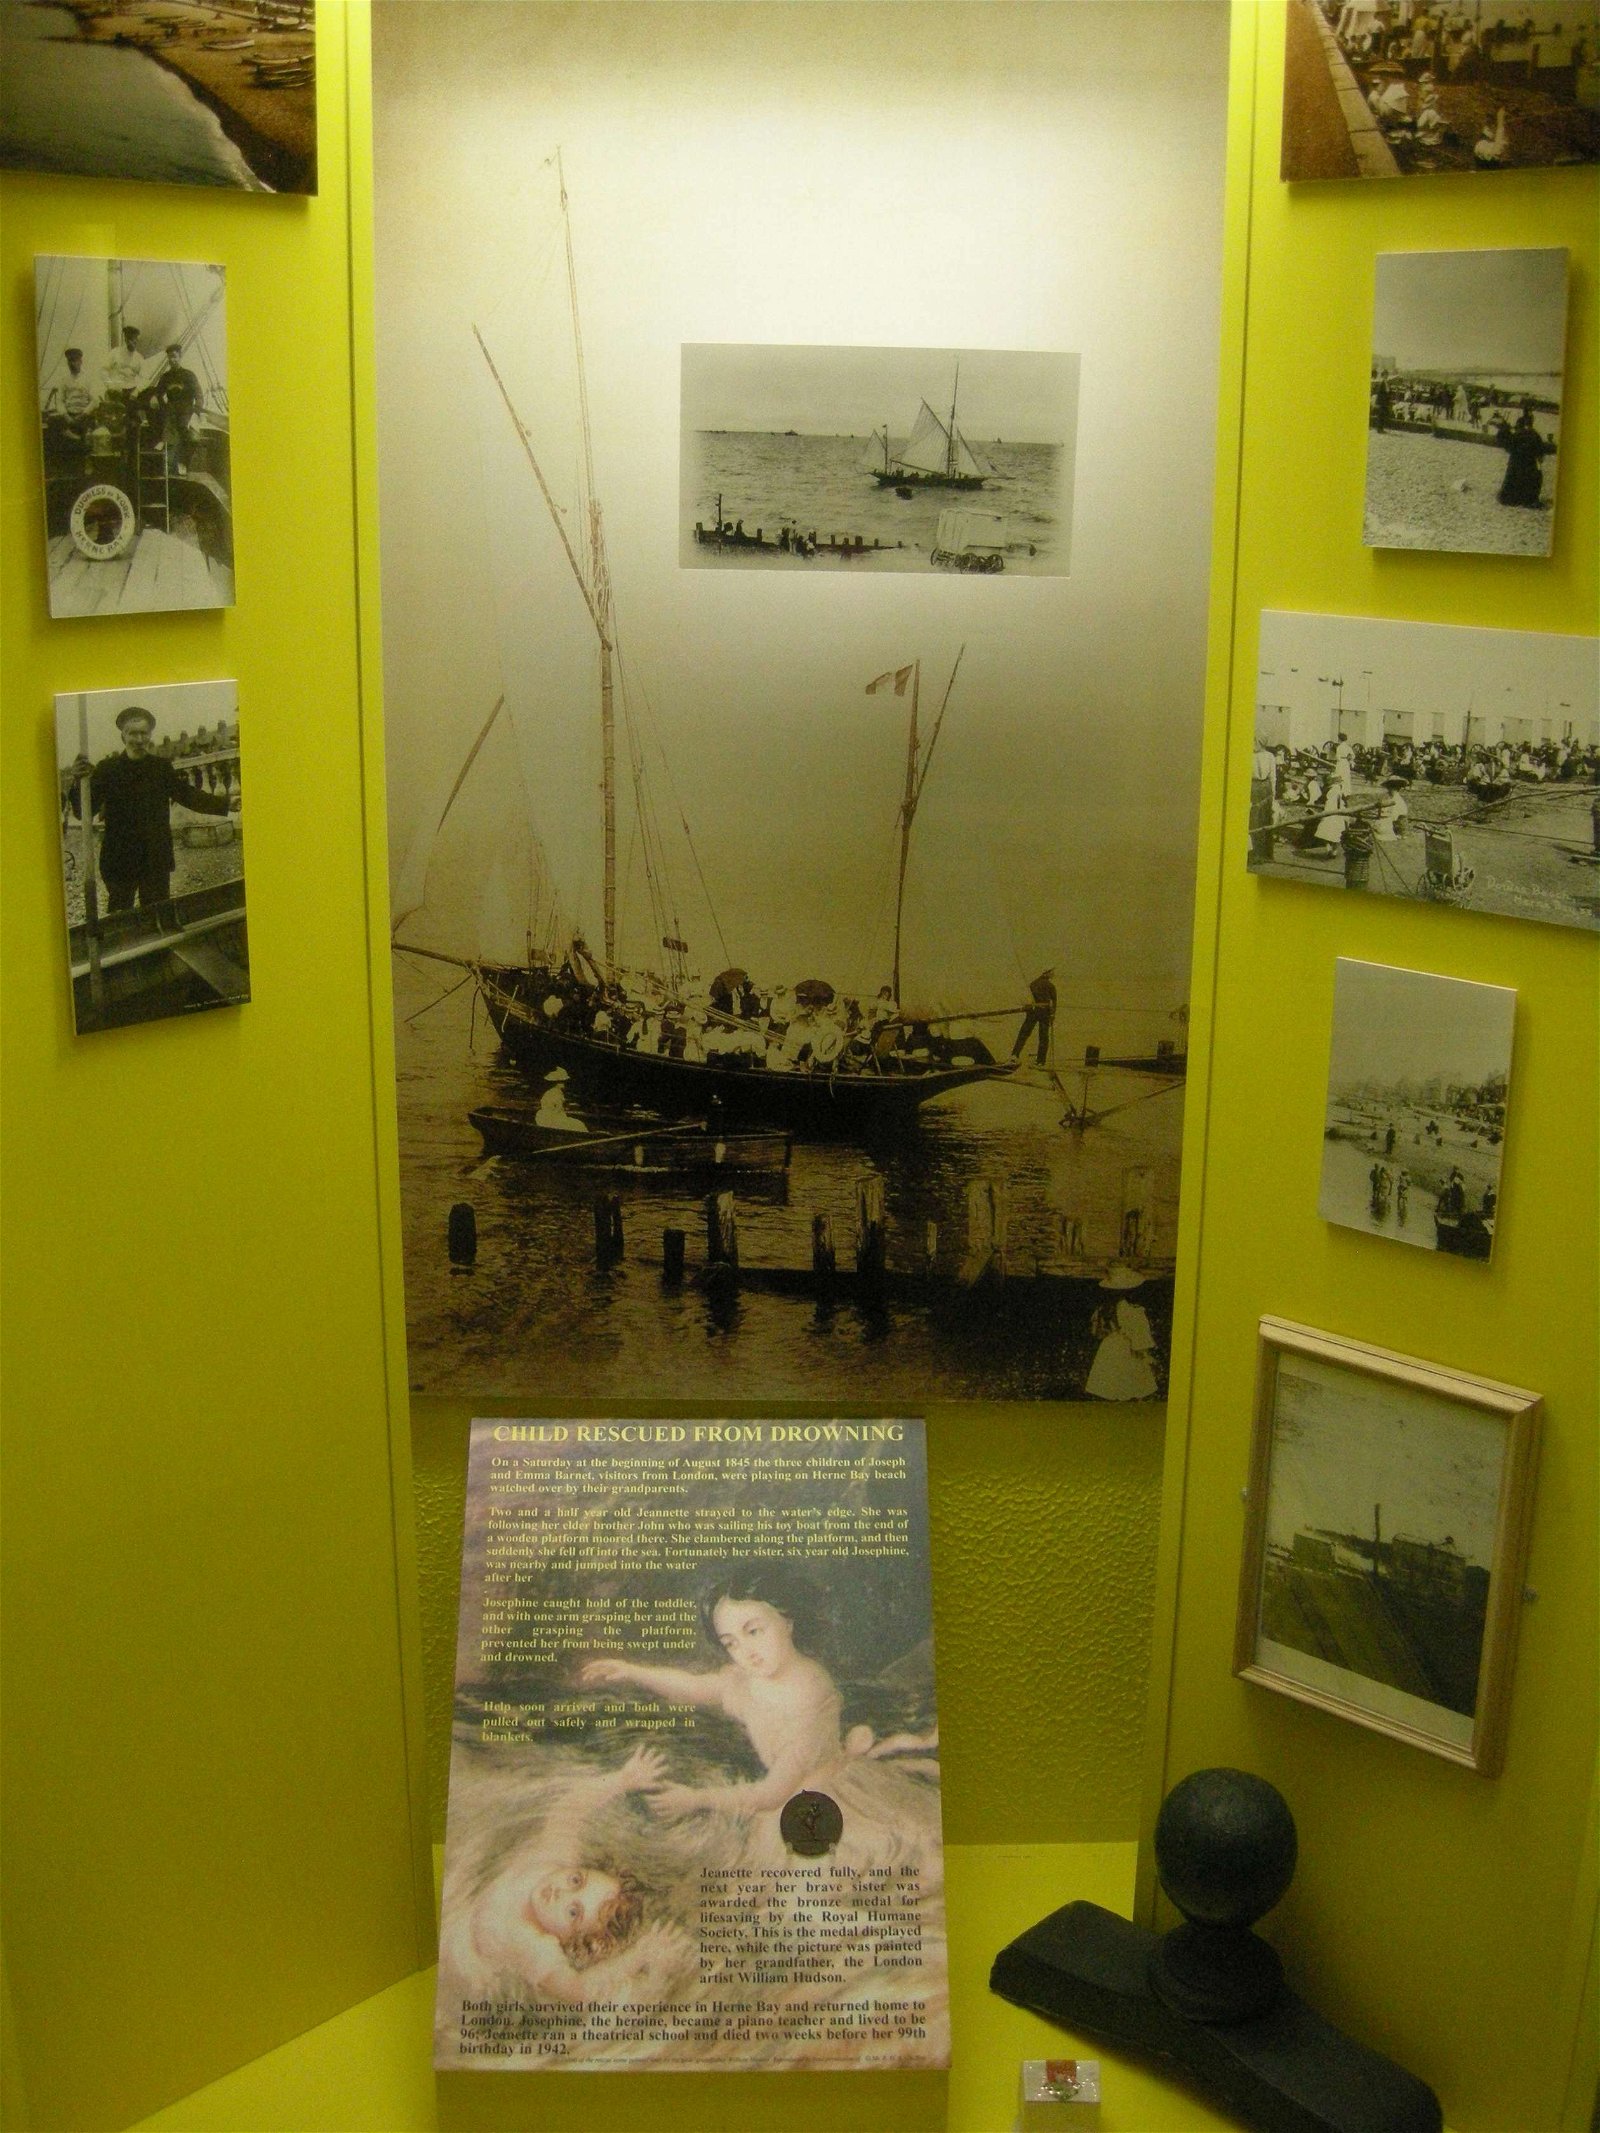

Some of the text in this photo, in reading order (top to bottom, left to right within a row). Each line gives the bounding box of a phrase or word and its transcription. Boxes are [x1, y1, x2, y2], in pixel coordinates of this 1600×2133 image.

[116, 493, 130, 519] YORK
[494, 1425, 904, 1442] CHILD RESCUED FROM DROWNING
[491, 1457, 508, 1467] On
[522, 1457, 572, 1469] Saturday
[576, 1457, 586, 1467] at
[590, 1457, 607, 1467] the
[611, 1457, 664, 1469] beginning
[668, 1457, 679, 1467] of
[682, 1457, 720, 1469] August
[726, 1457, 750, 1467] 1845
[753, 1457, 770, 1467] the
[774, 1457, 802, 1466] three
[805, 1457, 850, 1466] children
[854, 1457, 865, 1466] of
[868, 1457, 906, 1469] Joseph
[490, 1471, 510, 1480] and
[515, 1471, 550, 1480] Emma
[598, 1470, 638, 1480] visitors
[642, 1470, 668, 1480] from
[672, 1470, 718, 1481] London,
[751, 1470, 791, 1482] playing
[812, 1470, 846, 1480] Herne
[850, 1470, 869, 1482] Bay
[874, 1470, 906, 1480] beach
[490, 1483, 535, 1493] watched
[563, 1483, 578, 1496] by
[582, 1483, 608, 1493] their
[611, 1483, 688, 1495] grandparents.
[489, 1507, 512, 1517] Two
[517, 1507, 538, 1517] and
[557, 1507, 578, 1517] half
[583, 1510, 608, 1519] year
[613, 1507, 630, 1517] old
[636, 1507, 689, 1517] Jeannette
[694, 1507, 735, 1519] strayed
[741, 1507, 752, 1517] to
[758, 1507, 775, 1517] the
[827, 1507, 855, 1519] edge.
[861, 1507, 881, 1516] She
[483, 1598, 697, 1611] Josephine caught hold of the toddler,
[482, 1612, 503, 1621] and
[507, 1612, 530, 1621] with
[582, 1612, 631, 1624] grasping
[633, 1612, 652, 1621] her
[655, 1612, 676, 1621] and
[679, 1612, 697, 1621] the
[481, 1625, 512, 1635] other
[532, 1625, 583, 1637] grasping
[603, 1625, 621, 1635] the
[481, 1639, 696, 1651] prevented her from being swept under
[480, 1652, 558, 1662] and drowned.
[483, 1702, 511, 1715] Help
[553, 1702, 595, 1712] arrived
[604, 1702, 625, 1712] and
[634, 1702, 659, 1712] both
[482, 1718, 695, 1730] pulled out safely and wrapped in
[482, 1732, 534, 1742] blankets.
[700, 1866, 920, 1879] Jeanette recovered fully, and the
[700, 1883, 727, 1893] next
[737, 1885, 766, 1895] year
[775, 1882, 796, 1892] her
[805, 1882, 842, 1892] brave
[851, 1881, 887, 1892] sister
[700, 1895, 920, 1908] awarded the bronze medal for
[700, 1911, 921, 1925] lifesaving by the Royal Humane
[754, 1927, 779, 1937] This
[783, 1927, 792, 1937] is
[796, 1927, 815, 1937] the
[819, 1926, 858, 1937] medal
[861, 1926, 921, 1939] displayed
[700, 1941, 922, 1955] here, while the picture was painted
[700, 1956, 922, 1971] by her grandfather, the London
[699, 1972, 846, 1983] artist William Hudson.
[461, 1999, 925, 2015] Both girls survived their experience in Herne Bay and returned home to
[459, 2044, 570, 2058] birthday in 1942.
